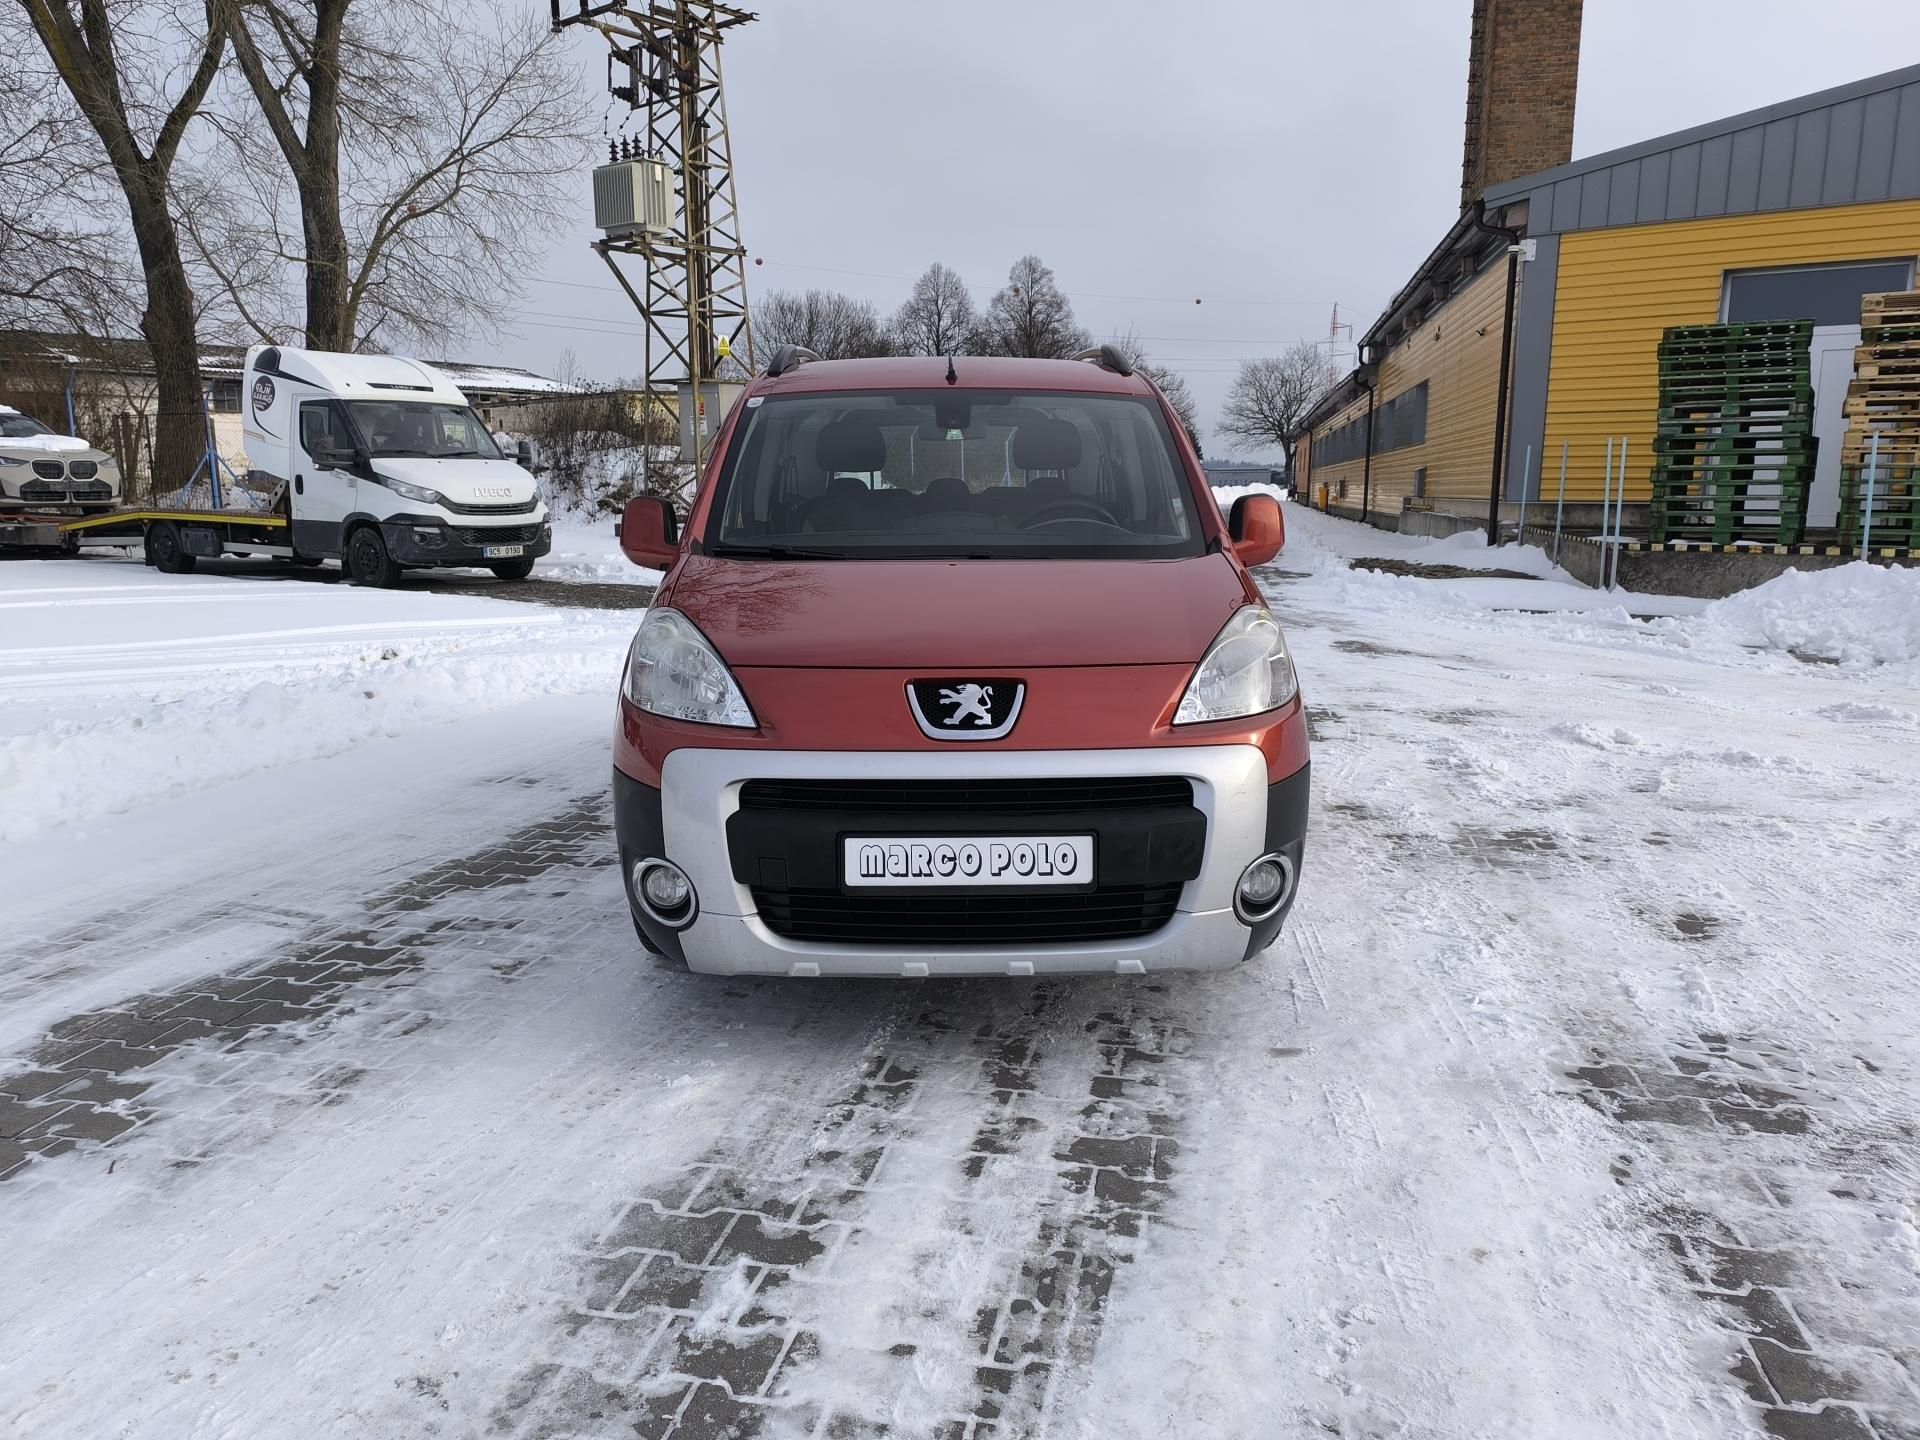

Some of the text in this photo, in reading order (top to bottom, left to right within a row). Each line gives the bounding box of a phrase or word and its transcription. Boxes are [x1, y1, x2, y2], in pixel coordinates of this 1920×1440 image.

[473, 488, 512, 497] IVECO
[489, 546, 521, 555] 9C5 0190
[990, 842, 1078, 877] POLO
